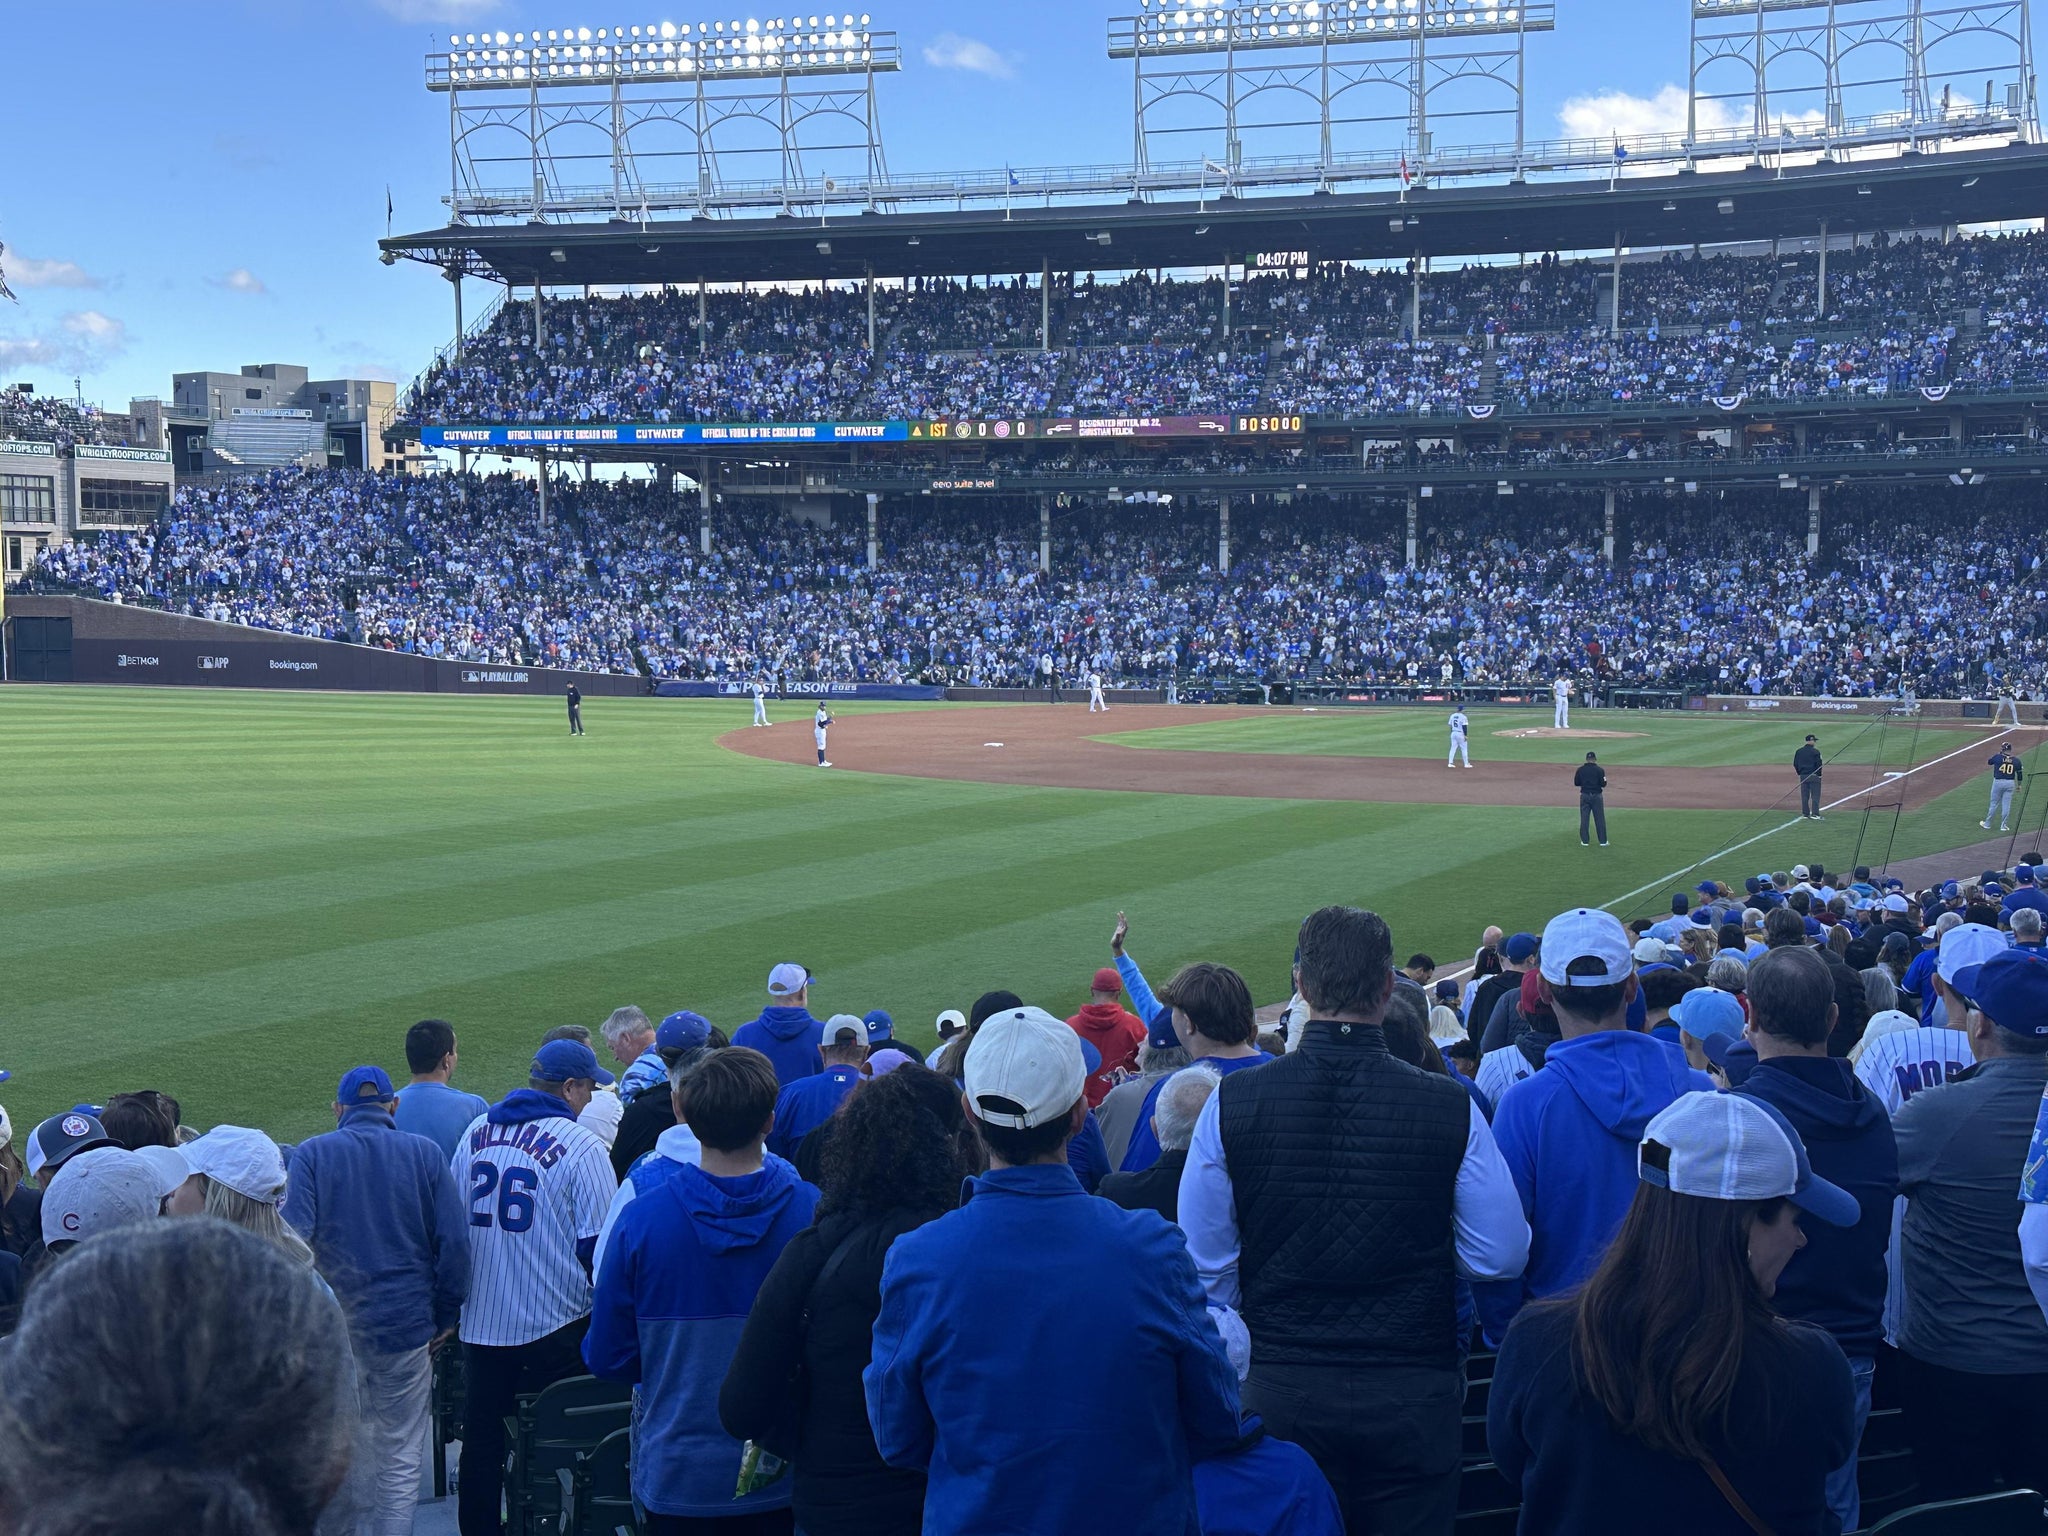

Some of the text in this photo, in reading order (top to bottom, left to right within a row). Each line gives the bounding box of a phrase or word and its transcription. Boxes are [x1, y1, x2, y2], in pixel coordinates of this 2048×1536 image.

[1256, 251, 1308, 266] 04:07 PM
[443, 430, 491, 441] CUTWATER
[635, 428, 685, 439] CUTWATER
[834, 426, 885, 437] CUTWATER
[79, 447, 167, 461] WRIGLEYROOFTOPS.COM
[932, 479, 995, 489] eero suite level
[127, 656, 159, 666] BETMGM
[214, 657, 229, 669] APP
[269, 659, 318, 671] Booking.com
[480, 671, 529, 683] PLAYBALL.ORG
[742, 682, 830, 693] PSTEASON
[1811, 701, 1858, 710] Booking.com
[1999, 763, 2014, 775] 40
[868, 1021, 877, 1030] C
[470, 1122, 567, 1169] WILLIAMS
[470, 1160, 539, 1232] 26
[62, 1213, 80, 1231] C
